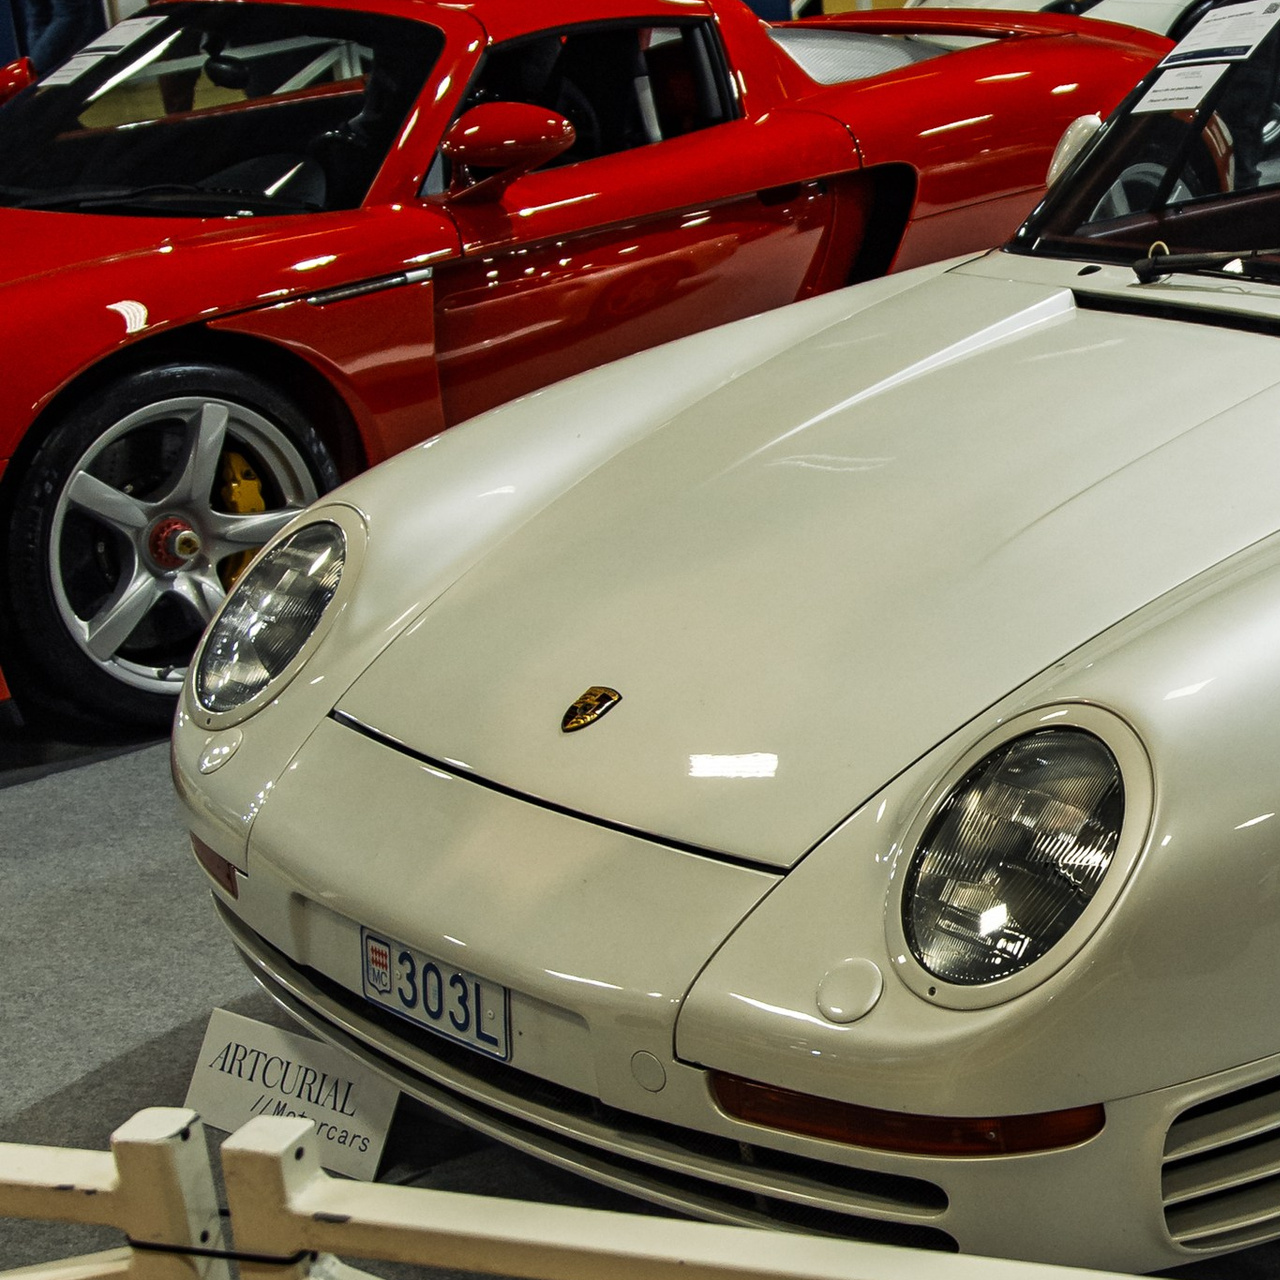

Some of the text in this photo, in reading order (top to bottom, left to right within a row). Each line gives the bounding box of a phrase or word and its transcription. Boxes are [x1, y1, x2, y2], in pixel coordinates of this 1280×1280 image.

[371, 967, 388, 987] MC
[397, 950, 499, 1047] 303L
[208, 1041, 357, 1117] ARTCURIAL
